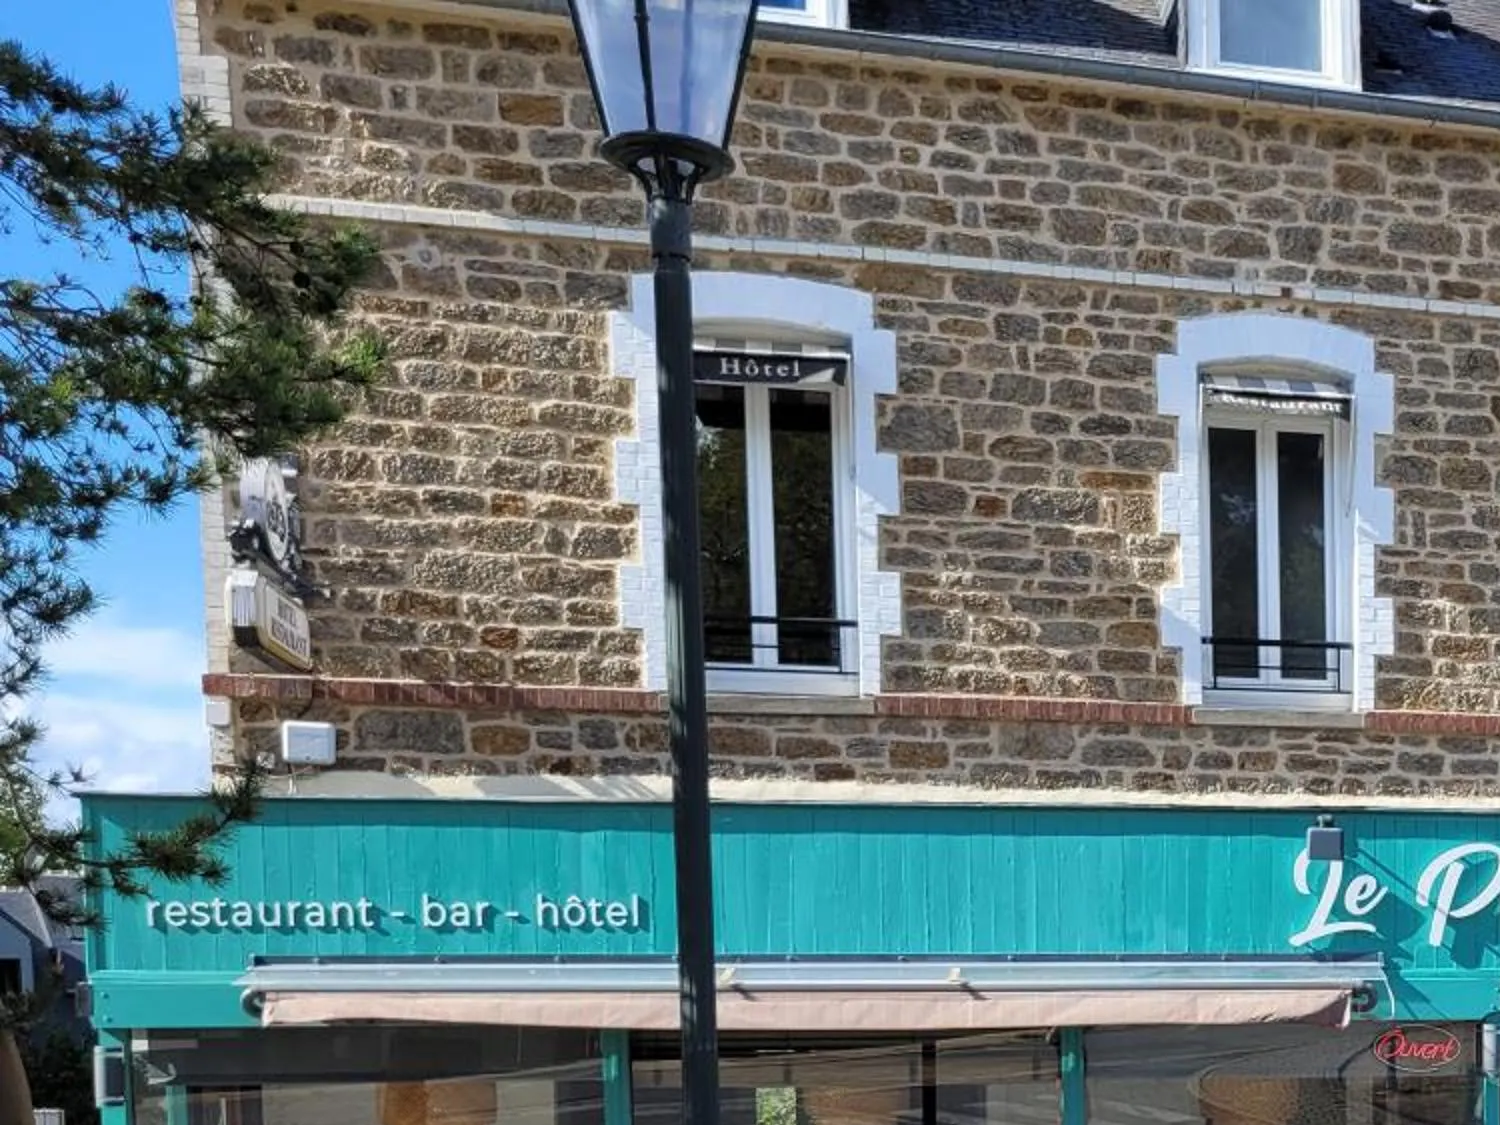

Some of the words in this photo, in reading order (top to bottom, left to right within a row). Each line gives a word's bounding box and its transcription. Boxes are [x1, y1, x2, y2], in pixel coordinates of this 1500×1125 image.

[719, 356, 801, 378] Hôtel
[145, 897, 376, 928] restaurant
[421, 893, 490, 928] bar
[536, 893, 641, 928] hôtel
[1288, 847, 1388, 947] Le
[1377, 1027, 1455, 1061] Ouvert
